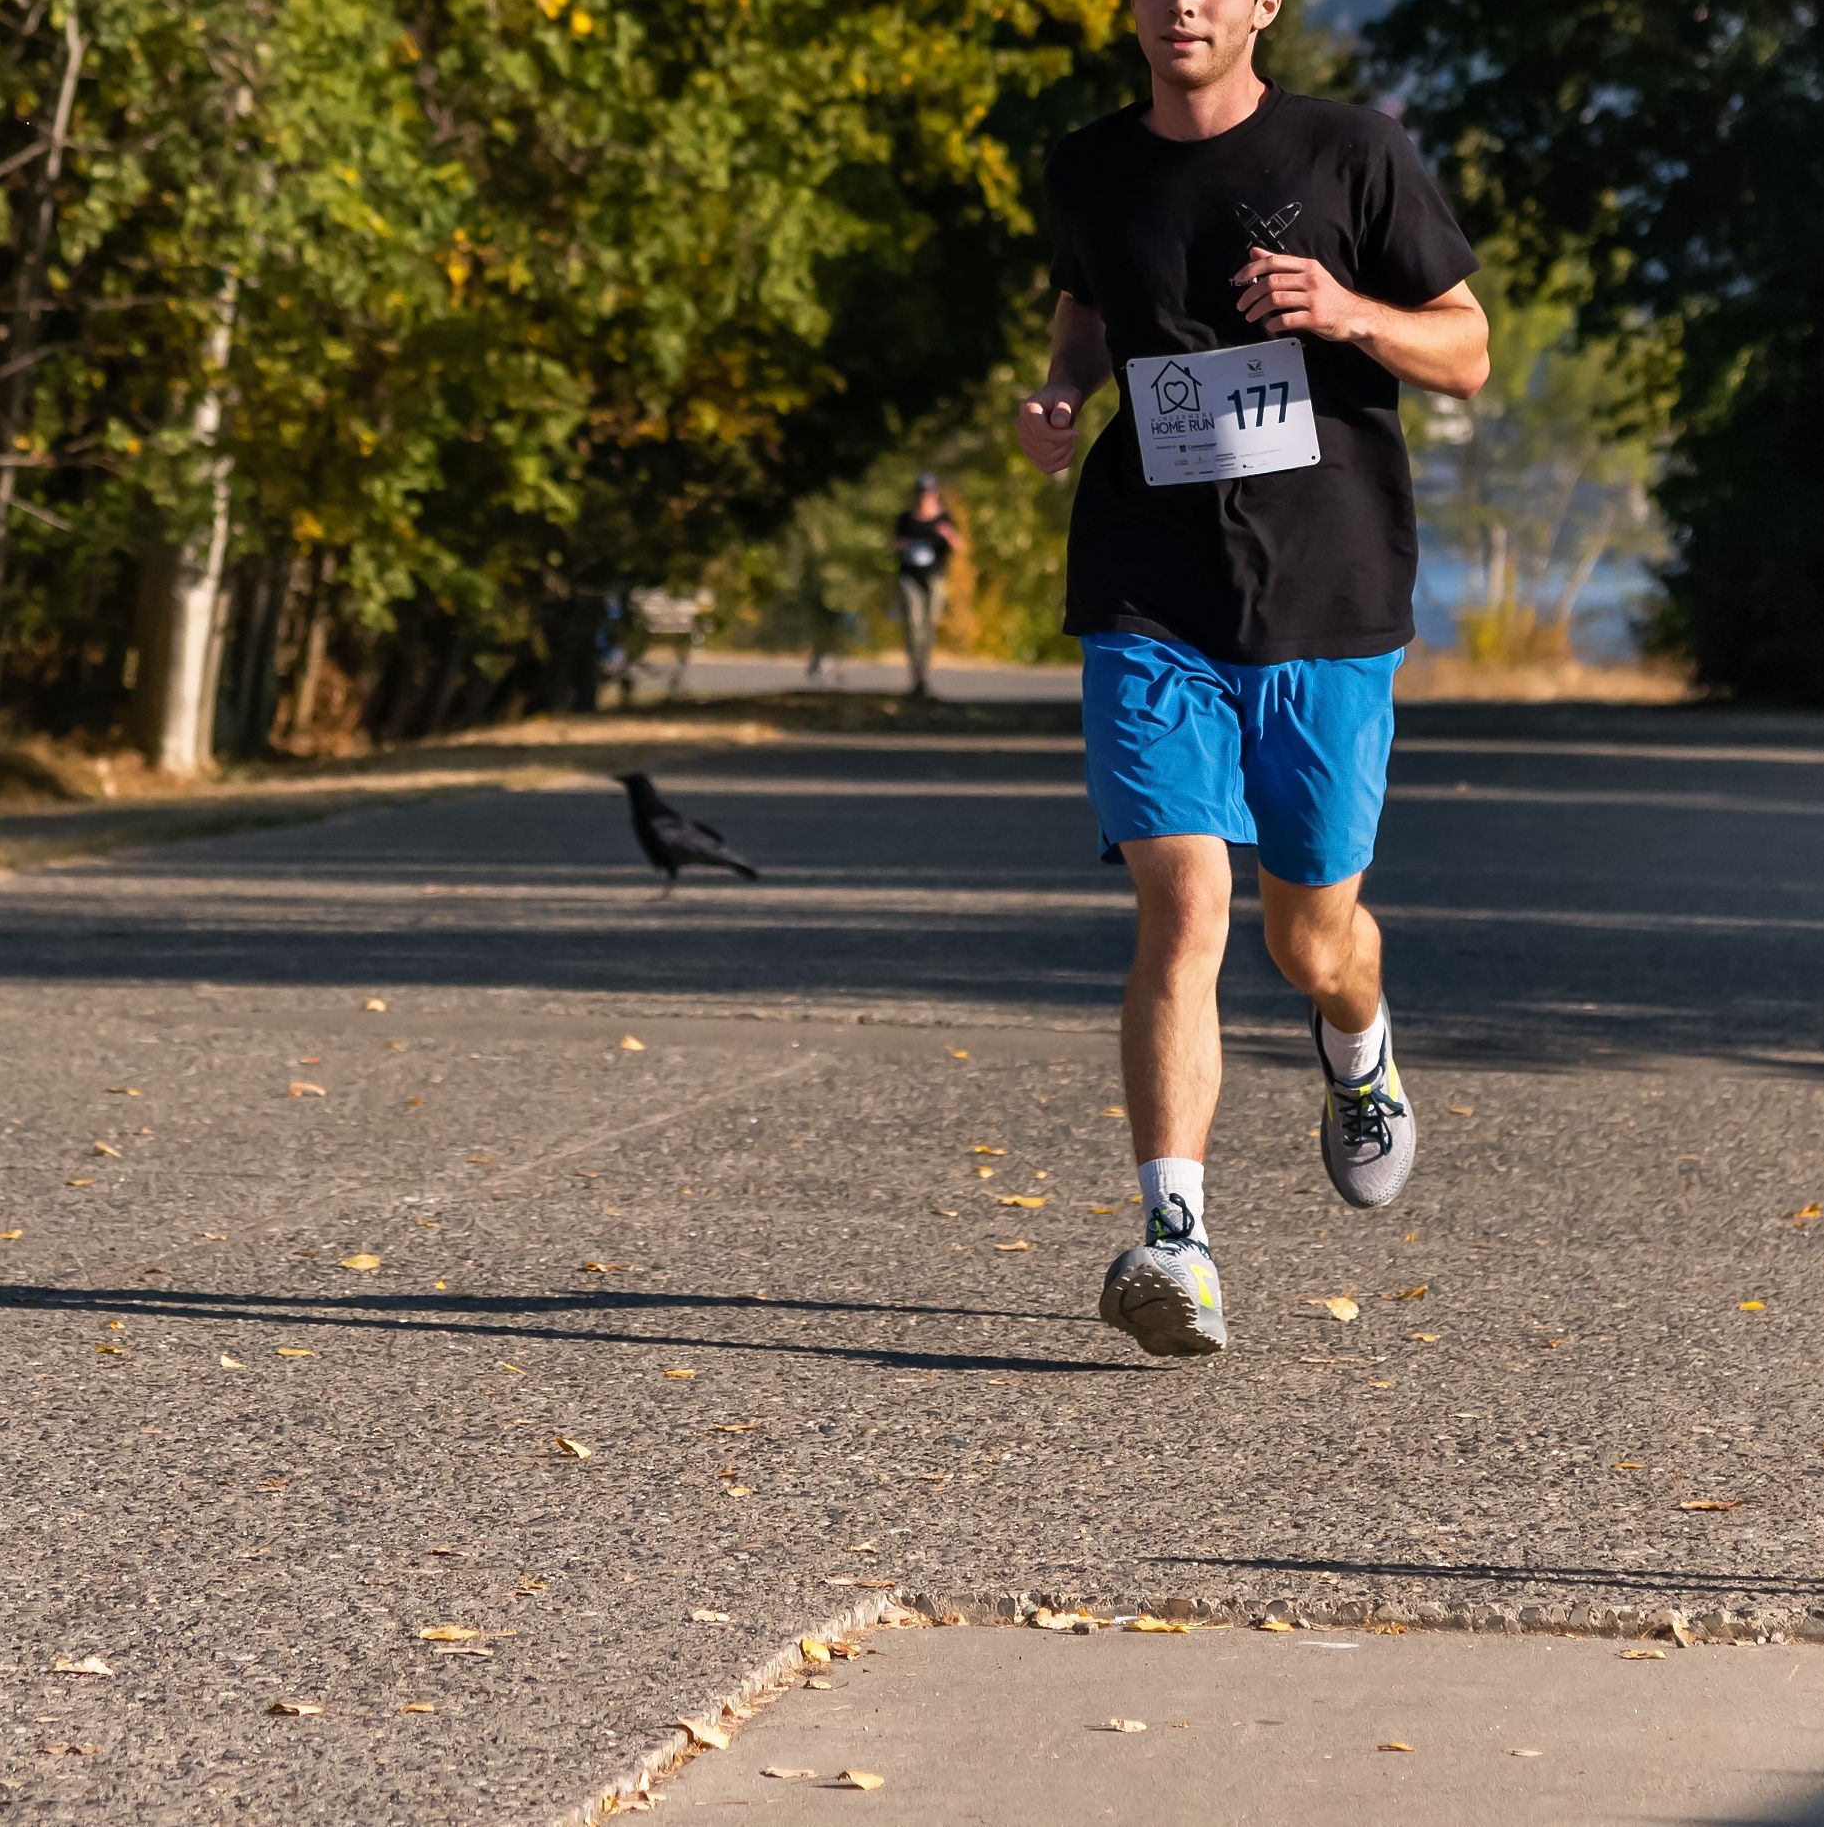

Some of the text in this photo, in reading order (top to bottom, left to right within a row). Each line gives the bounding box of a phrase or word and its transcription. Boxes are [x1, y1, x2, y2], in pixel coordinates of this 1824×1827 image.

[1227, 381, 1289, 430] 177
[1151, 417, 1215, 435] HOME RUN
